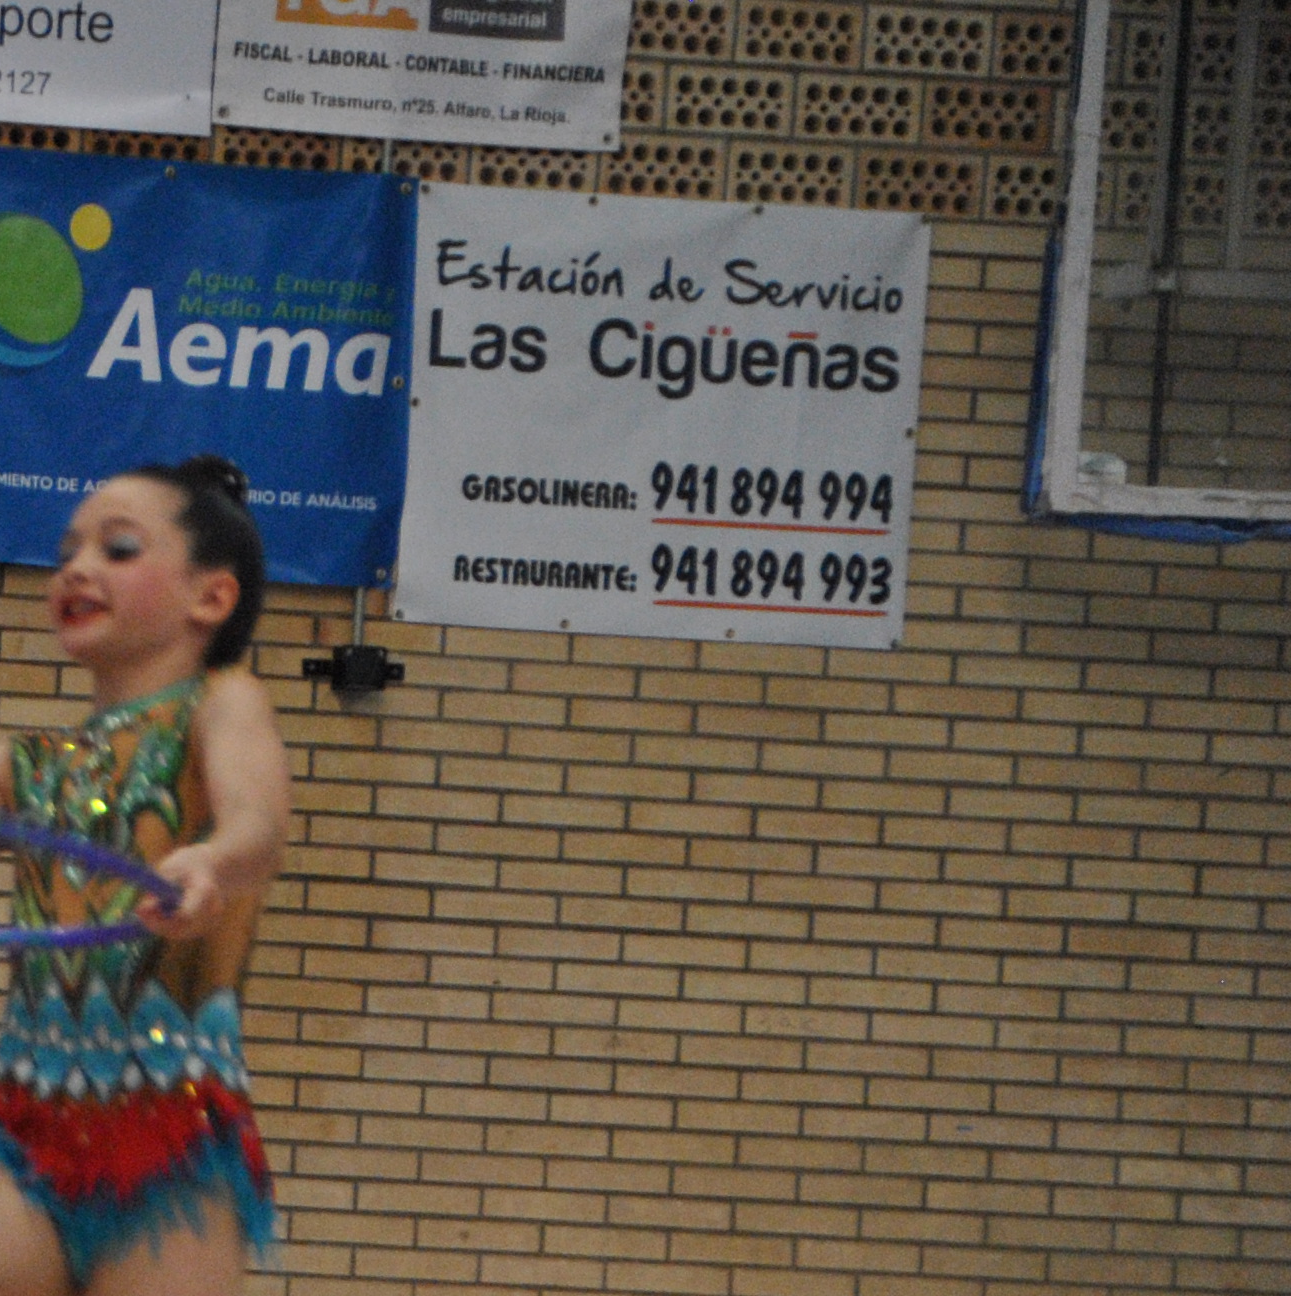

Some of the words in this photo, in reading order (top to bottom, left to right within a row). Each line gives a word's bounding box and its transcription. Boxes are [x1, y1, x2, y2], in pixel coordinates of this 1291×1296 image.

[441, 6, 548, 28] empresarial
[233, 41, 293, 63] FISCAL
[308, 48, 390, 69] LABORAL
[405, 55, 489, 77] CONTABLE
[502, 62, 606, 83] FINANCIERA
[263, 87, 306, 105] Calle
[500, 107, 521, 121] La
[436, 239, 624, 298] Estación
[648, 257, 705, 303] de
[725, 259, 903, 314] Servicio
[86, 288, 391, 396] Aema
[429, 308, 547, 373] Las
[589, 318, 900, 400] Cigüeñas
[58, 476, 79, 492] DE
[280, 491, 302, 506] DE
[461, 473, 637, 510] GASOLINERA:
[650, 461, 718, 513] 941
[731, 467, 804, 519] 894
[819, 471, 893, 523] 994
[454, 554, 637, 592] RESTAURANTE:
[650, 543, 718, 596] 941
[731, 550, 805, 600] 894
[820, 552, 893, 604] 993
